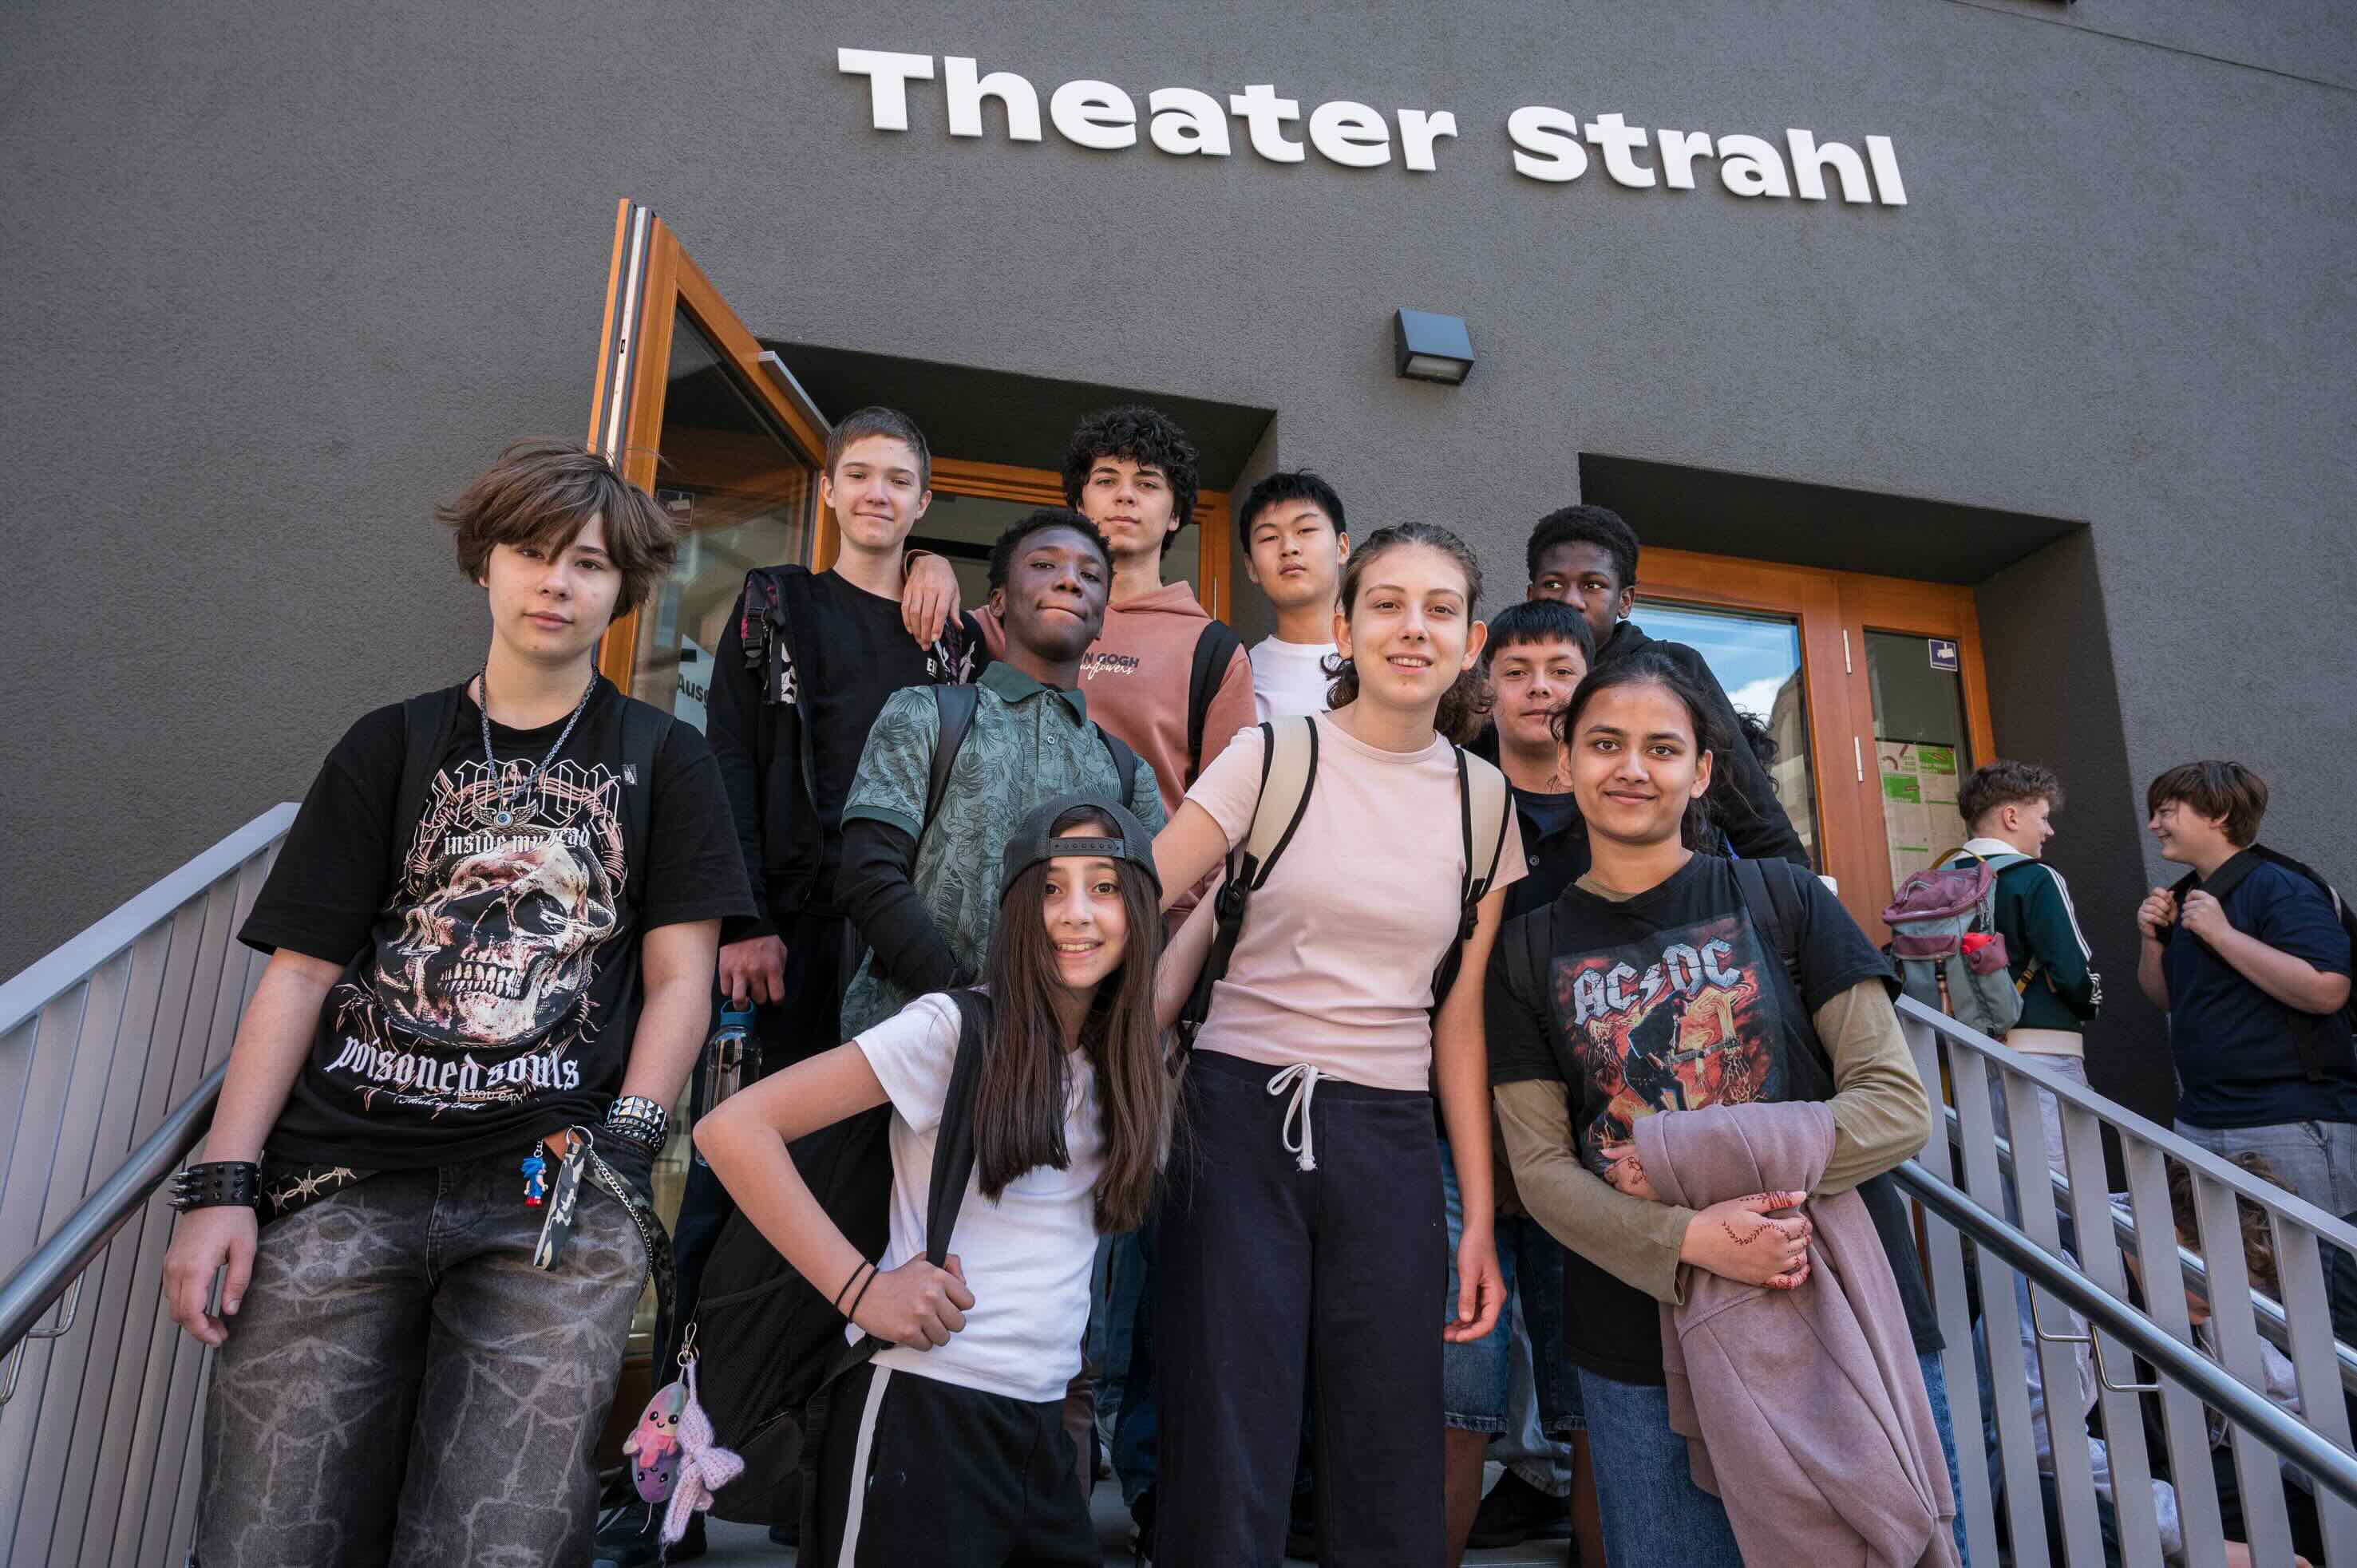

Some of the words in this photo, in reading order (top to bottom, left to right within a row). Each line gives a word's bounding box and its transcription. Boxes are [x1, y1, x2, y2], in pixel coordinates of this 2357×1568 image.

[837, 47, 1457, 169] Theater
[1507, 105, 1907, 204] Strahl
[1079, 655, 1135, 681] unflowers
[1097, 652, 1139, 668] GOGH
[444, 828, 507, 855] inside
[511, 833, 544, 855] my
[323, 1035, 480, 1092] poisoned
[485, 1047, 580, 1091] souls
[471, 1089, 496, 1100] YOU
